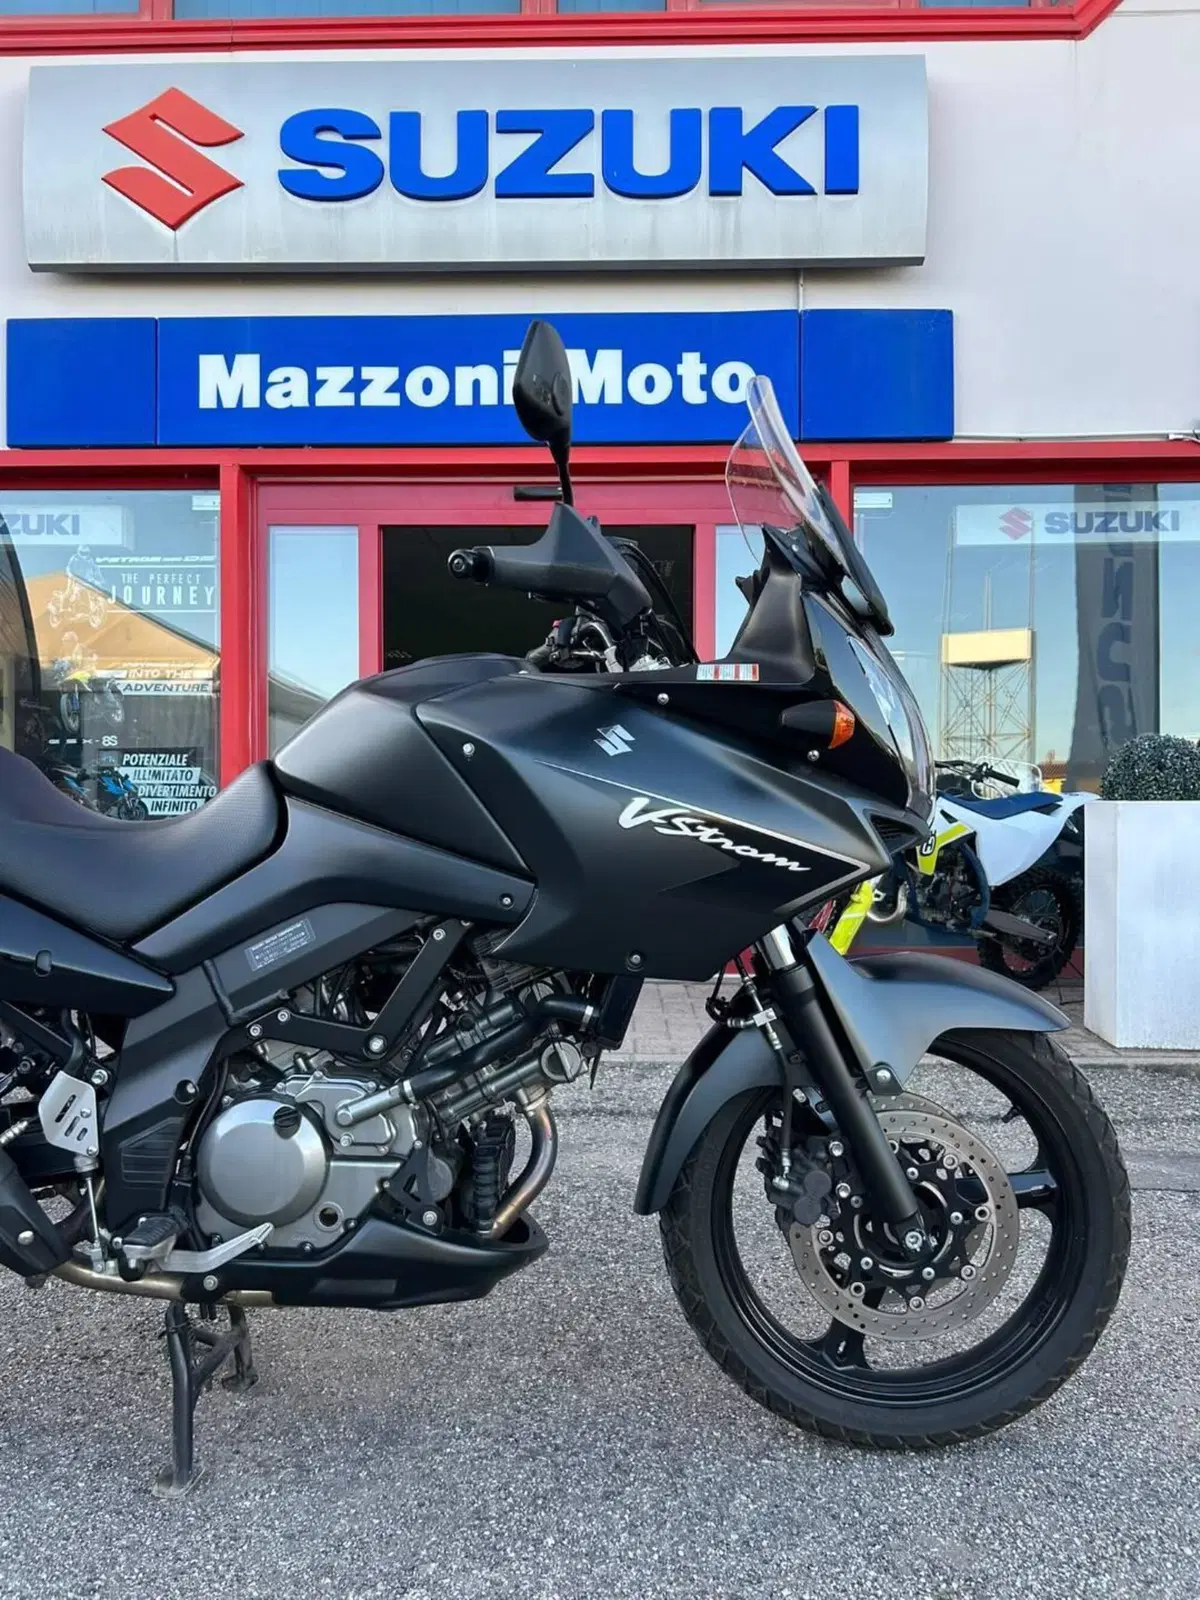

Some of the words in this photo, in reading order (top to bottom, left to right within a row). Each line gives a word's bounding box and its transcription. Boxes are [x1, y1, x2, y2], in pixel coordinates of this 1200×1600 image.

[278, 104, 860, 201] SUZUKI
[198, 354, 520, 409] Mazzoni
[565, 348, 757, 405] Moto
[1043, 509, 1180, 535] SUZUKI
[121, 573, 139, 585] THE
[149, 573, 201, 585] PERFECT
[107, 585, 215, 605] JOURNEY
[128, 669, 161, 678] INTO
[123, 683, 209, 692] ADVENTURE
[122, 753, 189, 766] POTENZIALE
[132, 769, 194, 782] ILLIMITATO
[138, 785, 217, 798] DIVERTIMENTO
[150, 800, 198, 812] INFINITO
